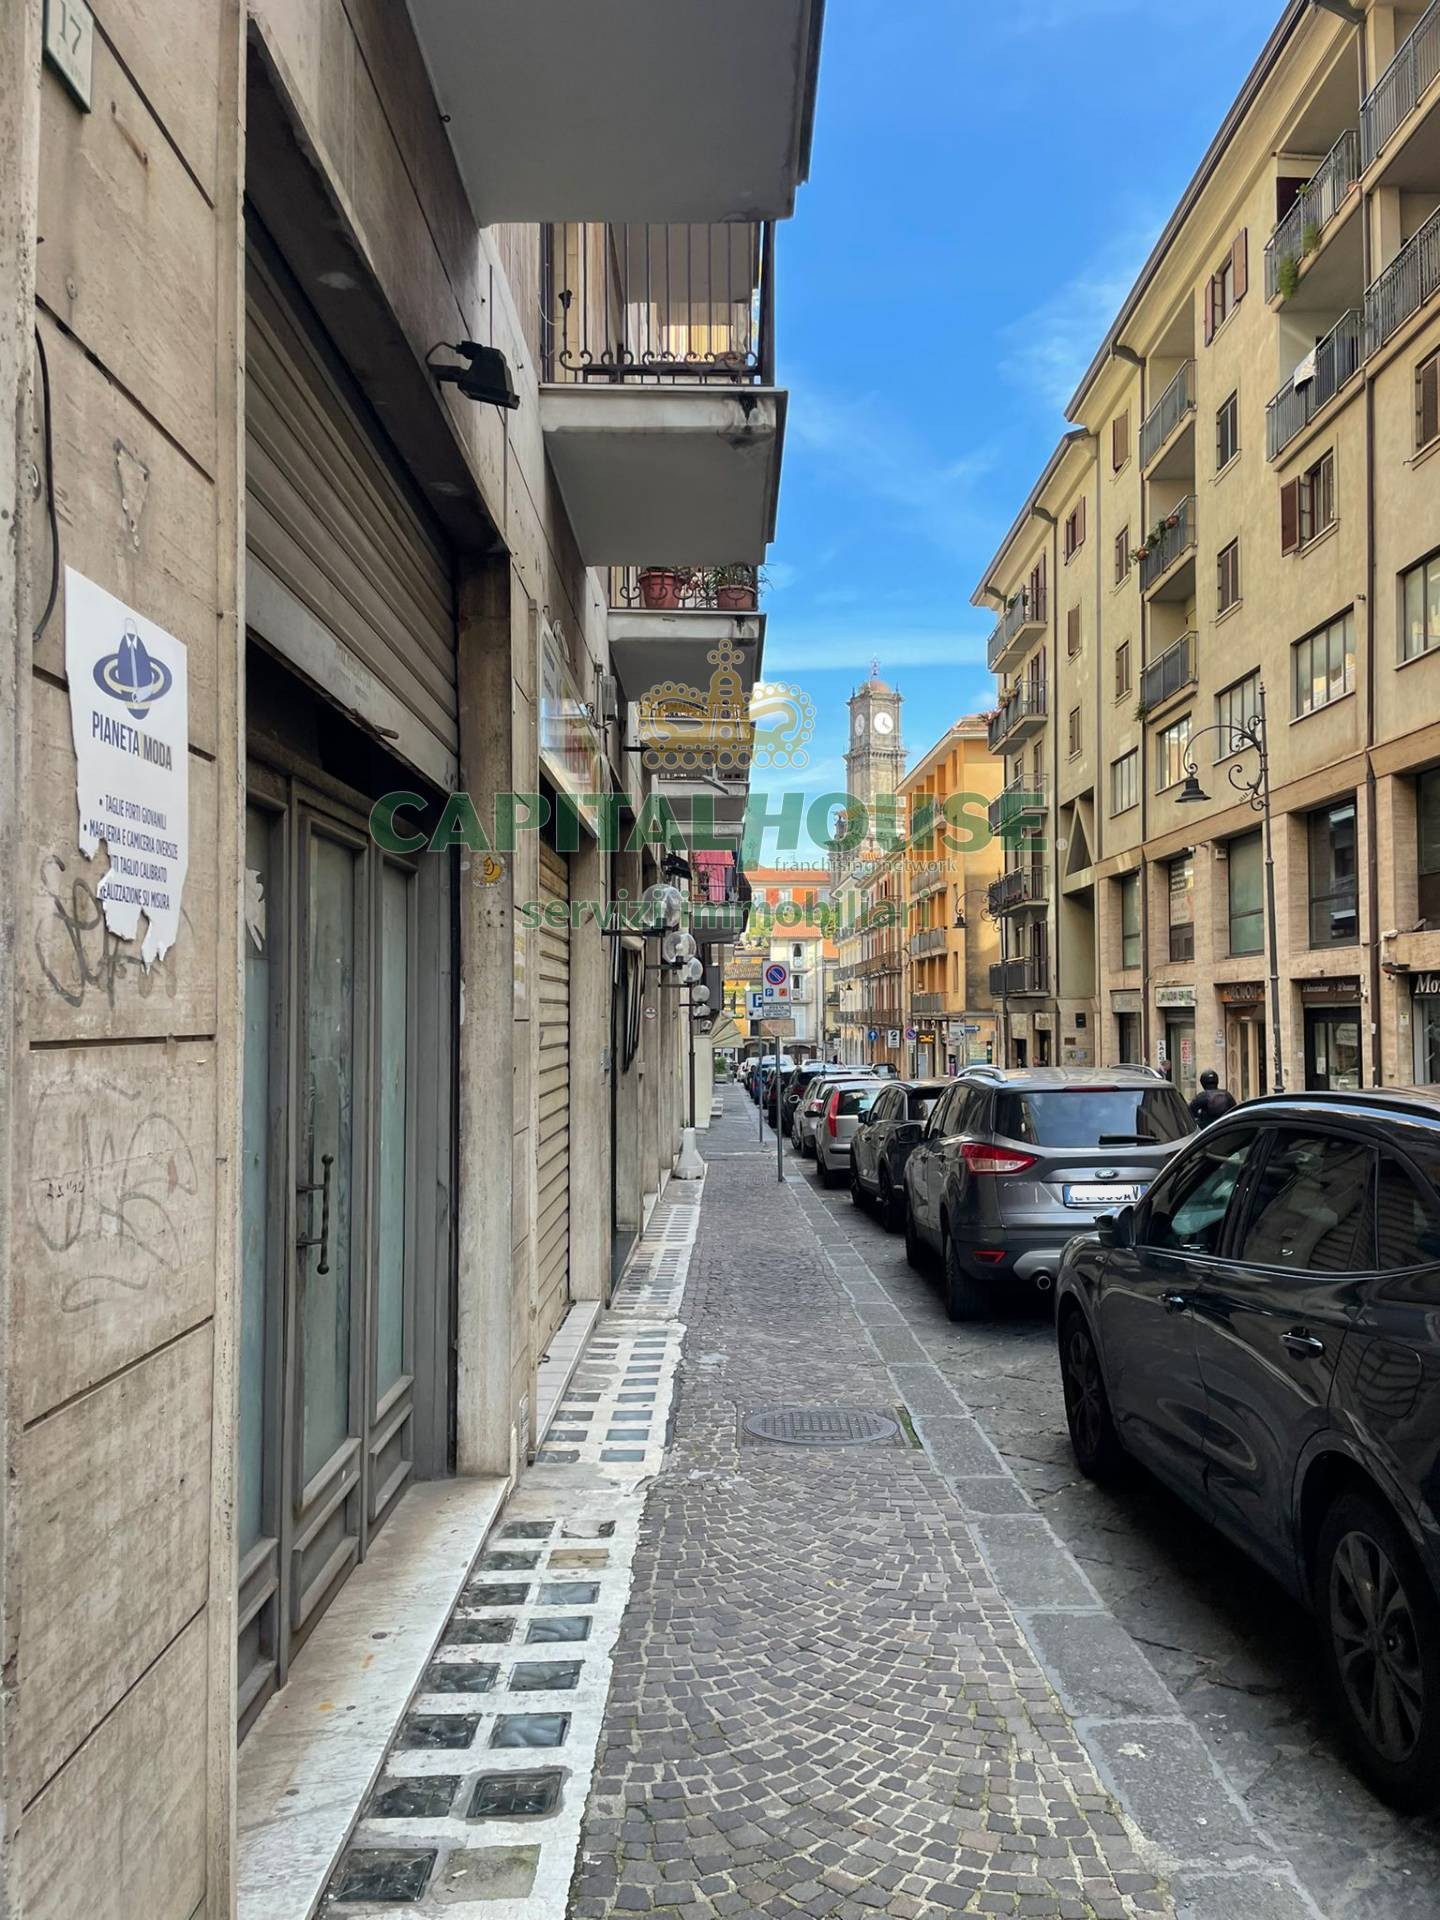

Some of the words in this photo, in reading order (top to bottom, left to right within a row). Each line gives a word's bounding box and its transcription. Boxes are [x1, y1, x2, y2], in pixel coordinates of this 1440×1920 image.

[92, 711, 140, 757] PIANETA
[143, 734, 172, 771] MODA
[105, 794, 124, 817] TAGLIE
[125, 801, 140, 822] FORTI
[142, 807, 166, 830] GIOVANILI
[122, 829, 126, 846] E
[127, 830, 155, 855] CAMICERIA
[156, 838, 178, 860] OVERSIZE
[120, 856, 138, 877] TAGLIO
[140, 862, 167, 883] CALIBRATO
[142, 890, 149, 907] SU
[150, 891, 169, 911] MISURA
